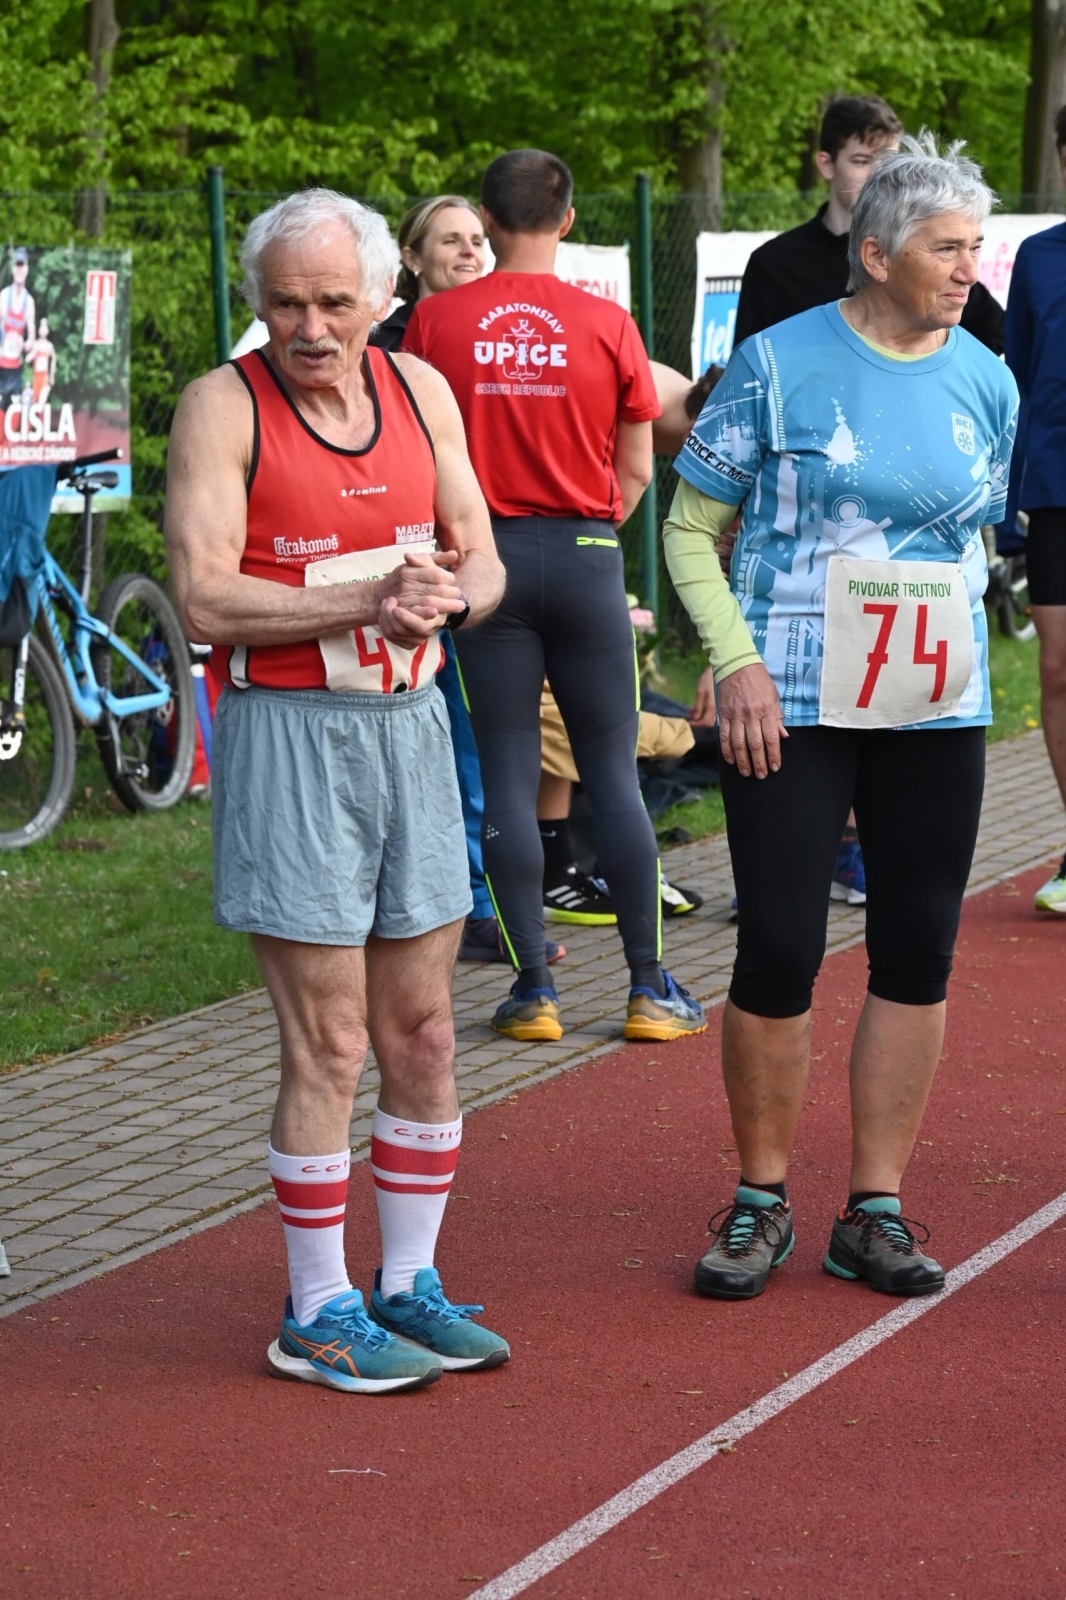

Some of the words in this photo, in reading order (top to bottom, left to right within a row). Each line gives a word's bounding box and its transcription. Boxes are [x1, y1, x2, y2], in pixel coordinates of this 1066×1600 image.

[478, 303, 564, 333] MARATONSTAV
[474, 383, 511, 395] CZECH
[513, 385, 566, 397] REPUBLIC
[276, 556, 307, 564] pivovar
[849, 580, 899, 597] PIVOVAR
[902, 583, 951, 597] TRUTNOV
[856, 603, 948, 708] 74
